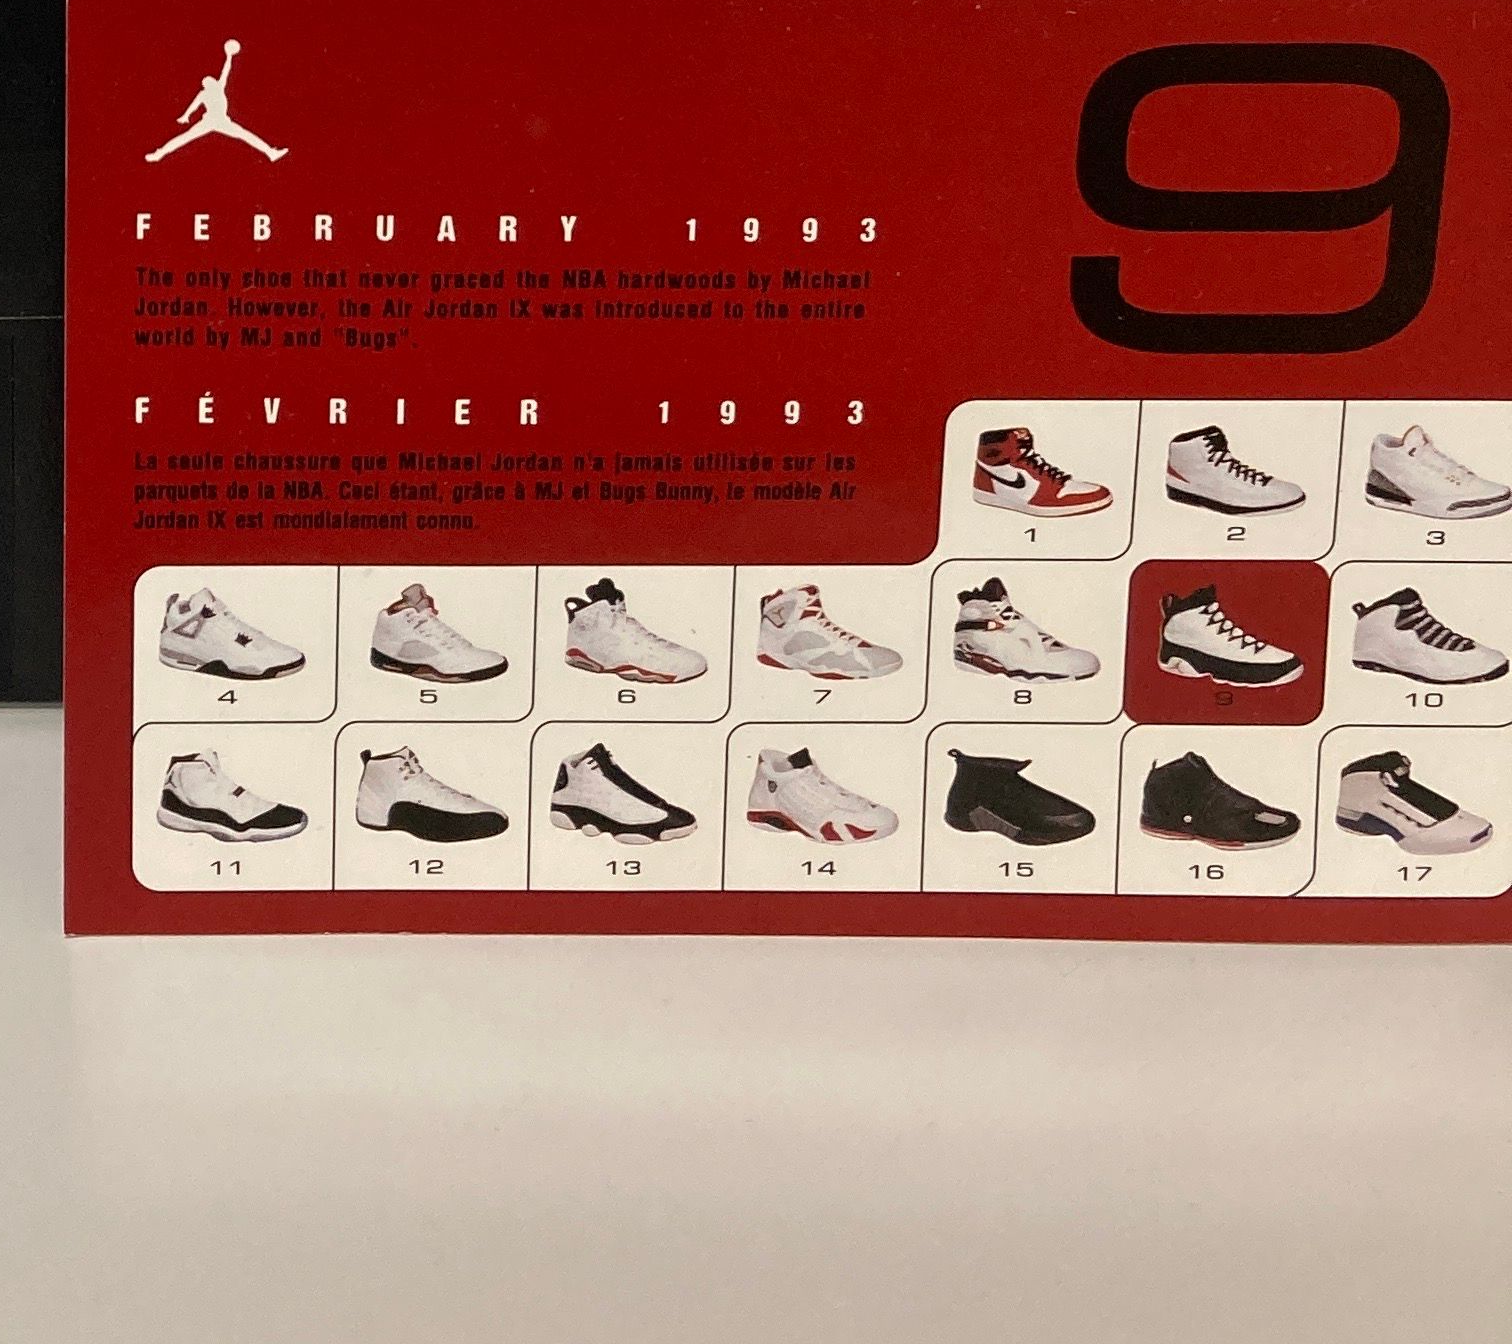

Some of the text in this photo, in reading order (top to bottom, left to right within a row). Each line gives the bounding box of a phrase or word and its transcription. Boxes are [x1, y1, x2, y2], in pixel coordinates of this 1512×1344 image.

[1070, 42, 1451, 355] 9
[135, 213, 877, 243] FEBRUARY 1993
[137, 267, 870, 293] The only shoe that never graced the NBA hardwoods by Michael
[339, 299, 371, 318] the
[382, 299, 413, 318] Air
[424, 299, 498, 319] Jordan
[510, 300, 530, 318] IX
[542, 302, 583, 318] was
[595, 300, 713, 319] introduced
[723, 301, 744, 319] to
[755, 300, 789, 319] the
[800, 301, 865, 319] entire
[135, 327, 194, 346] world
[206, 327, 229, 349] by
[241, 327, 272, 347] MJ
[283, 328, 322, 347] and
[135, 391, 864, 425] FÉVRIER 1993
[134, 452, 157, 471] La
[234, 453, 340, 471] chaussure
[351, 455, 388, 475] que
[398, 452, 482, 472] Michael
[491, 452, 563, 472] Jordan
[615, 453, 682, 475] jamais
[783, 456, 815, 472] sur
[826, 453, 856, 471] les
[134, 482, 217, 503] parquets
[226, 481, 249, 500] de
[257, 481, 275, 500] la
[340, 481, 379, 500] Ceci
[514, 480, 525, 500] à
[534, 481, 563, 501] MJ
[572, 482, 589, 500] et
[599, 481, 646, 503] Bugs
[655, 481, 719, 504] Bunny,
[726, 481, 745, 500] le
[829, 481, 856, 500] Air
[134, 510, 199, 529] Jordan
[207, 510, 226, 528] IX
[235, 511, 264, 529] est
[1024, 527, 1037, 543] 1
[1226, 526, 1247, 542] 2
[1425, 530, 1445, 546] 3
[217, 690, 238, 705] 4
[419, 690, 438, 704] 5
[617, 690, 637, 704] 6
[813, 690, 832, 705] 7
[1013, 689, 1033, 705] 8
[1404, 692, 1444, 708] 10
[210, 860, 242, 876] 11
[408, 860, 445, 875] 12
[606, 860, 642, 876] 13
[800, 860, 837, 876] 14
[997, 862, 1034, 878] 15
[1189, 864, 1225, 880] 16
[1396, 865, 1433, 882] 17
